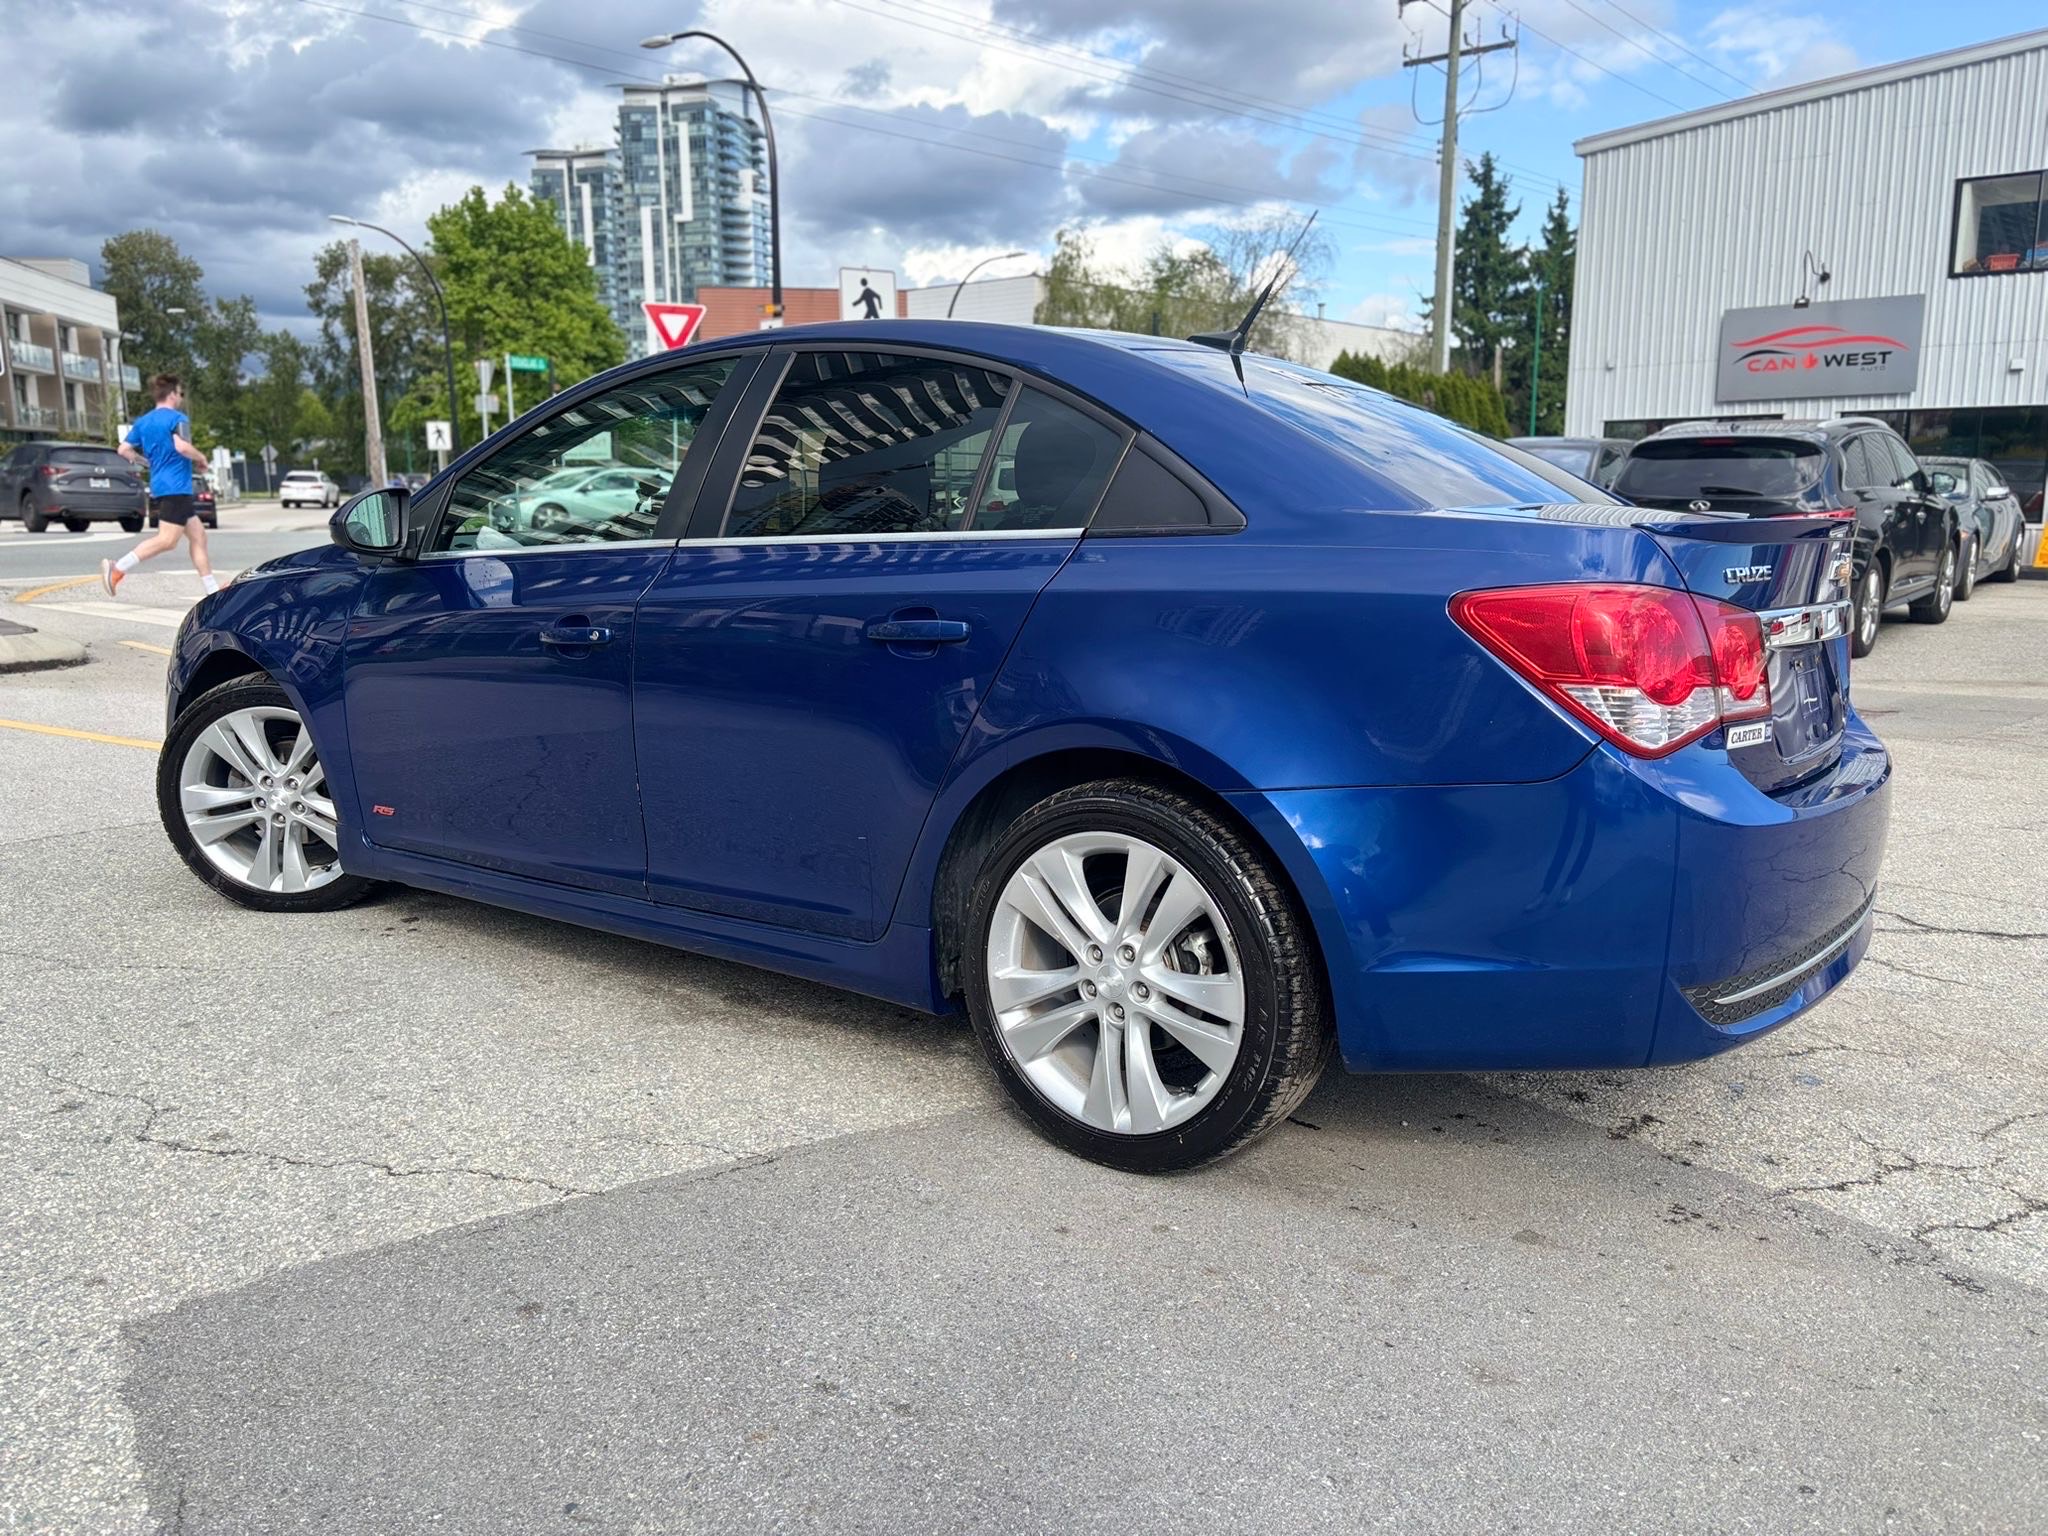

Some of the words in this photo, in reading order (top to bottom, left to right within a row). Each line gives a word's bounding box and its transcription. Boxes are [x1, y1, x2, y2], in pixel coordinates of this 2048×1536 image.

[1746, 358, 1797, 373] CAN
[1824, 351, 1893, 368] WEST
[1724, 564, 1772, 582] CRUZE
[1731, 727, 1762, 744] CARTER
[372, 804, 395, 816] RS
